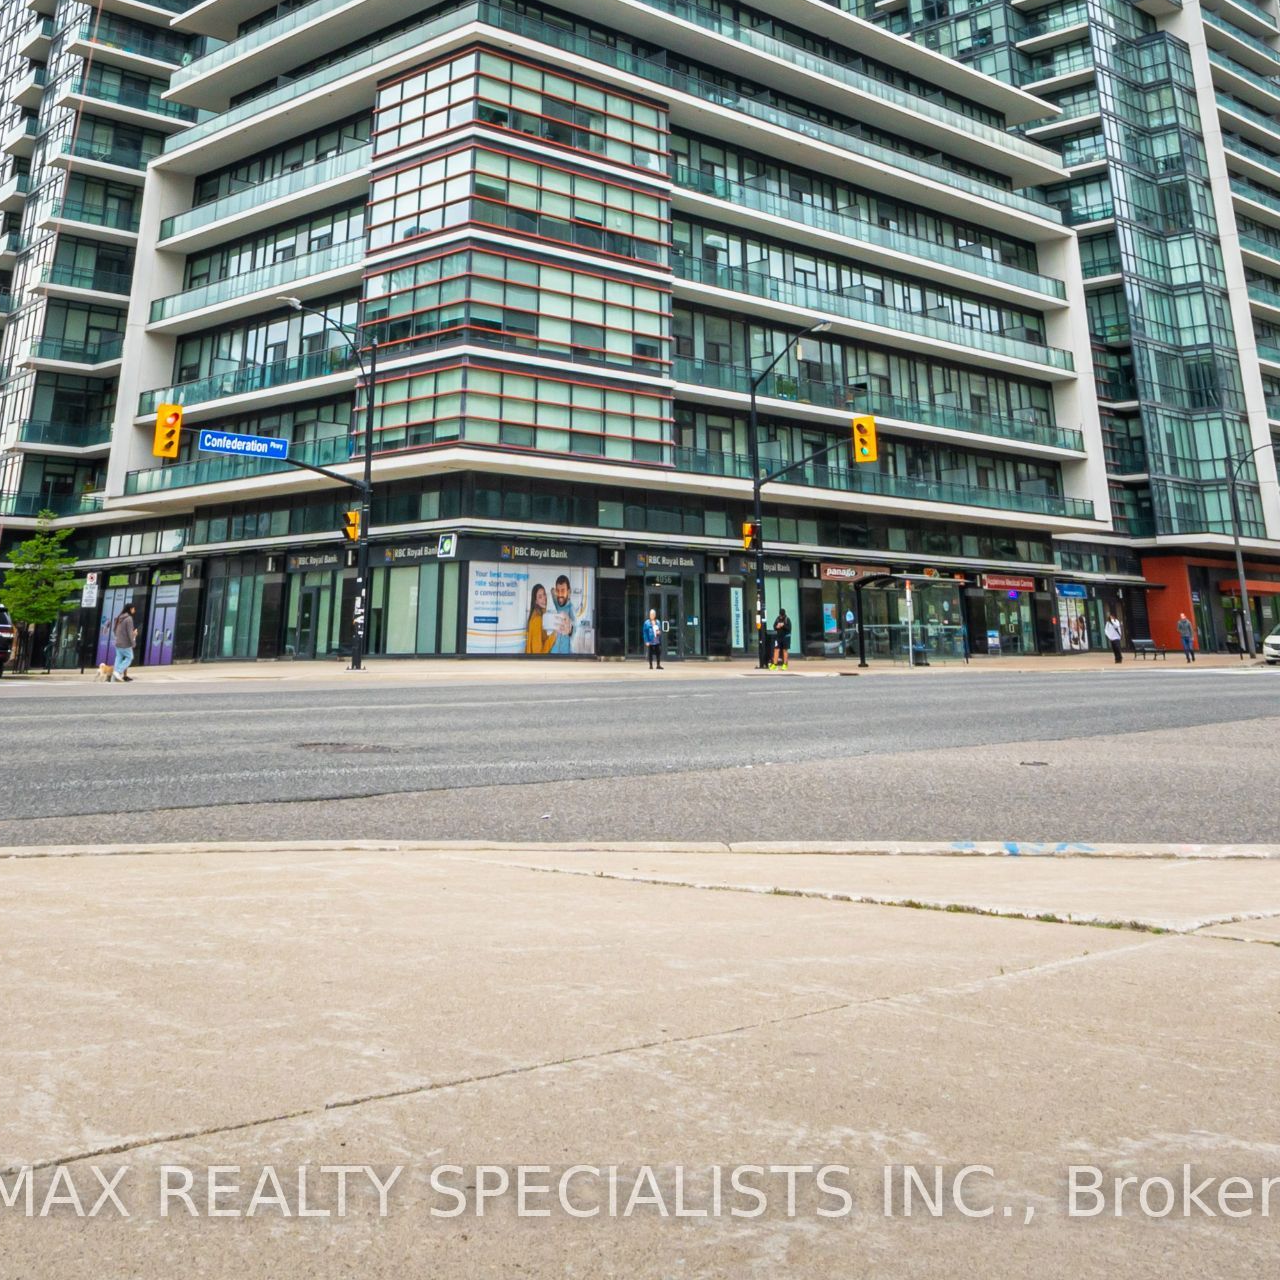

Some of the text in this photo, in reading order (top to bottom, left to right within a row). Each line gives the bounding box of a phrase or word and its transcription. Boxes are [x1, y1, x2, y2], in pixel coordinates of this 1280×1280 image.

[204, 434, 268, 453] Confederation
[394, 545, 439, 558] RBC Royal Bank
[514, 547, 568, 559] RBC Royal Bank
[310, 556, 323, 566] Royal
[324, 554, 338, 563] Bank
[648, 555, 695, 567] RBC Royal Bank
[777, 563, 791, 572] Bank
[826, 567, 856, 577] panago
